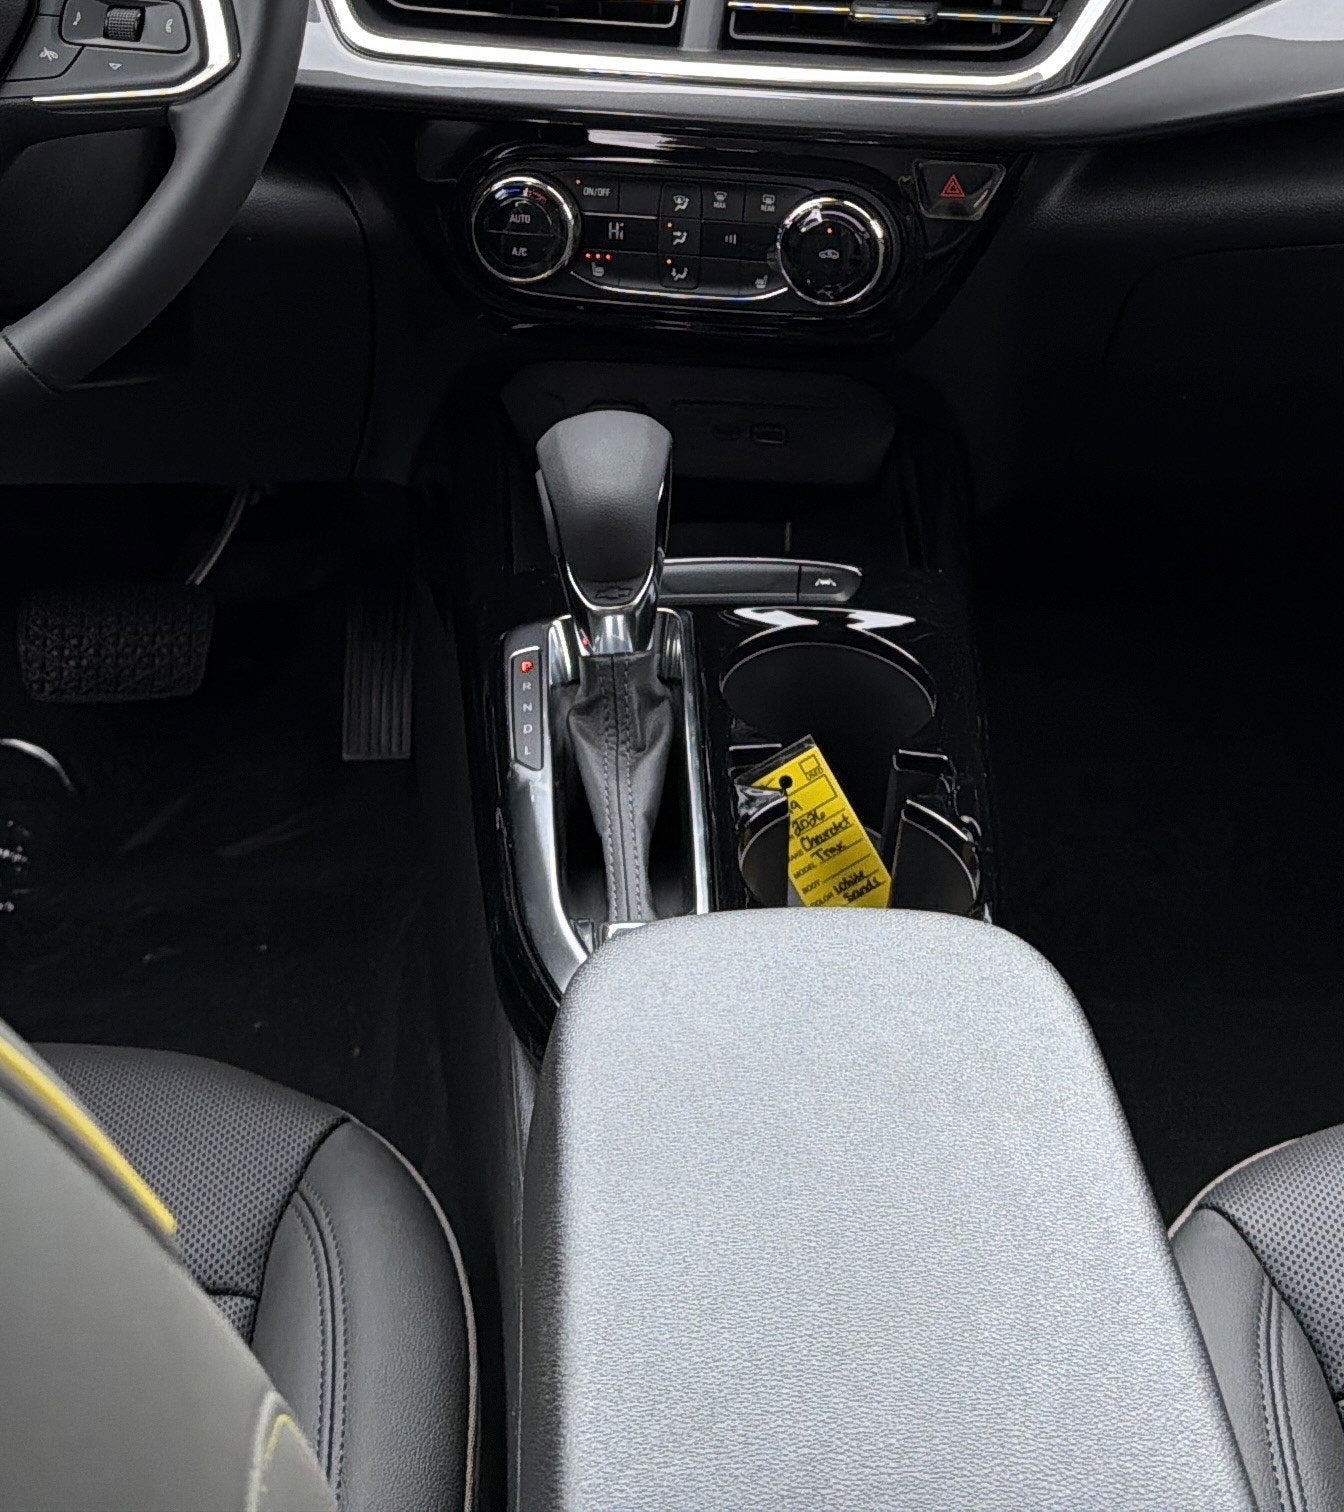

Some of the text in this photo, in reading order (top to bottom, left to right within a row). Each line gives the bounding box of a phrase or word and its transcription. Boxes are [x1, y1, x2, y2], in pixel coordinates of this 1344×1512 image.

[583, 186, 611, 197] ON/OFF
[509, 214, 531, 224] AUTO
[608, 221, 625, 240] Hi
[511, 247, 528, 256] A/C
[521, 660, 533, 673] P
[522, 681, 532, 691] R
[522, 702, 533, 712] N
[523, 723, 533, 734] D
[524, 745, 531, 756] L
